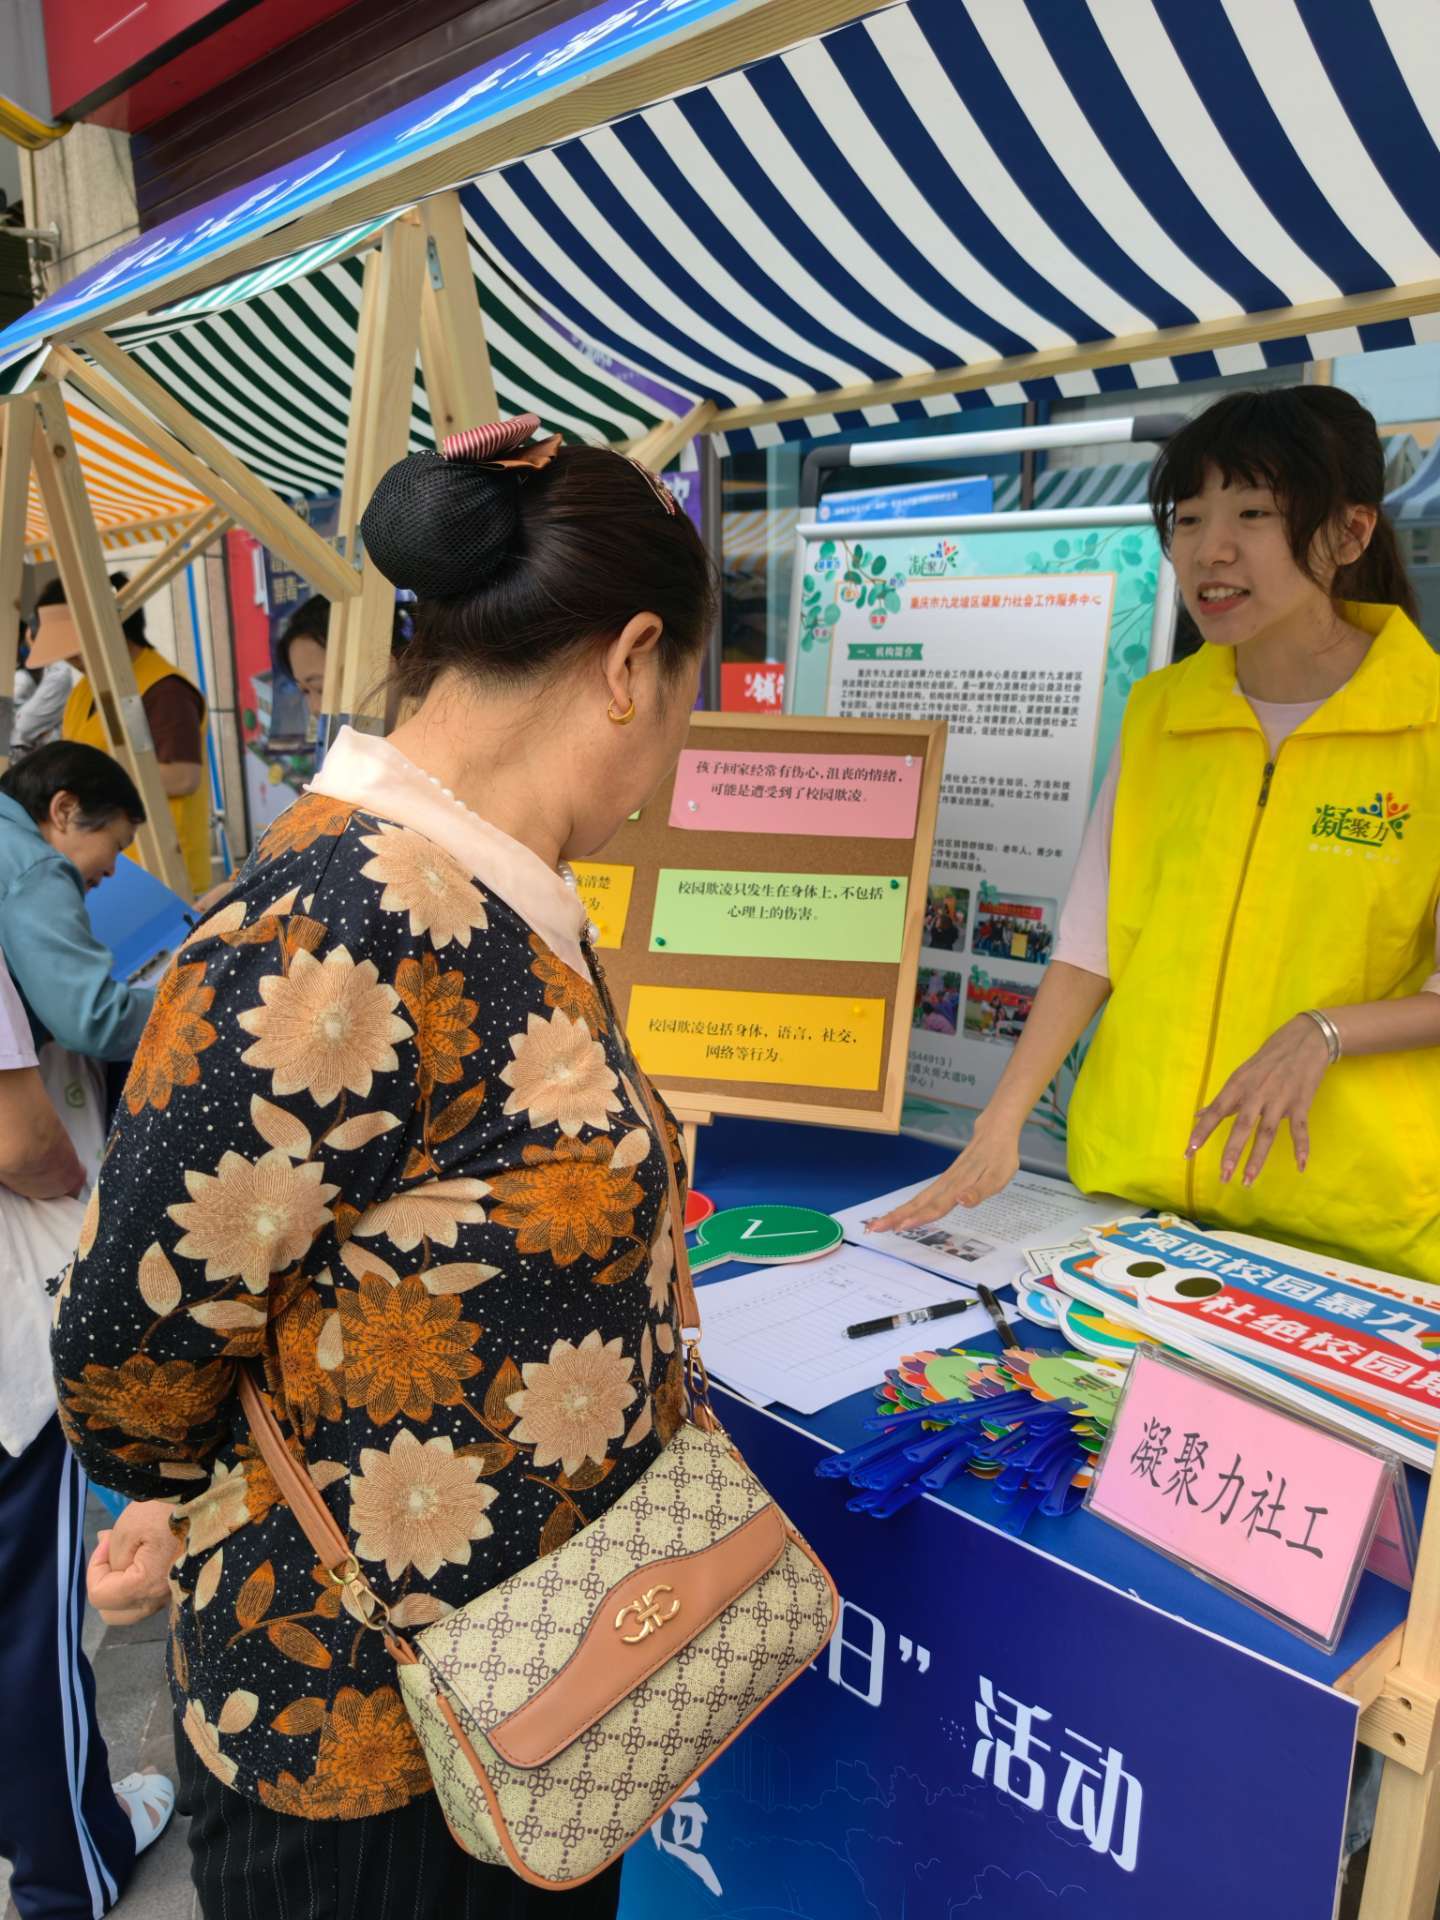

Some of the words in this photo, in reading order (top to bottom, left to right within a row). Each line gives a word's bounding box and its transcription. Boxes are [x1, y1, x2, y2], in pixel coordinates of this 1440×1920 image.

[910, 593, 1102, 609] 重庆市九龙坡区凝聚力社会工作服务中心
[938, 796, 995, 808] 作事业的发展。
[933, 849, 981, 862] 作专业服务。
[727, 905, 818, 920] 心理上的伤害。
[705, 1045, 784, 1062] 网络等行为。
[1127, 1227, 1430, 1338] 预防校园暴力
[1130, 1416, 1329, 1559] 凝聚力社工
[808, 1596, 931, 1707] 日”
[971, 1674, 1143, 1872] 活动
